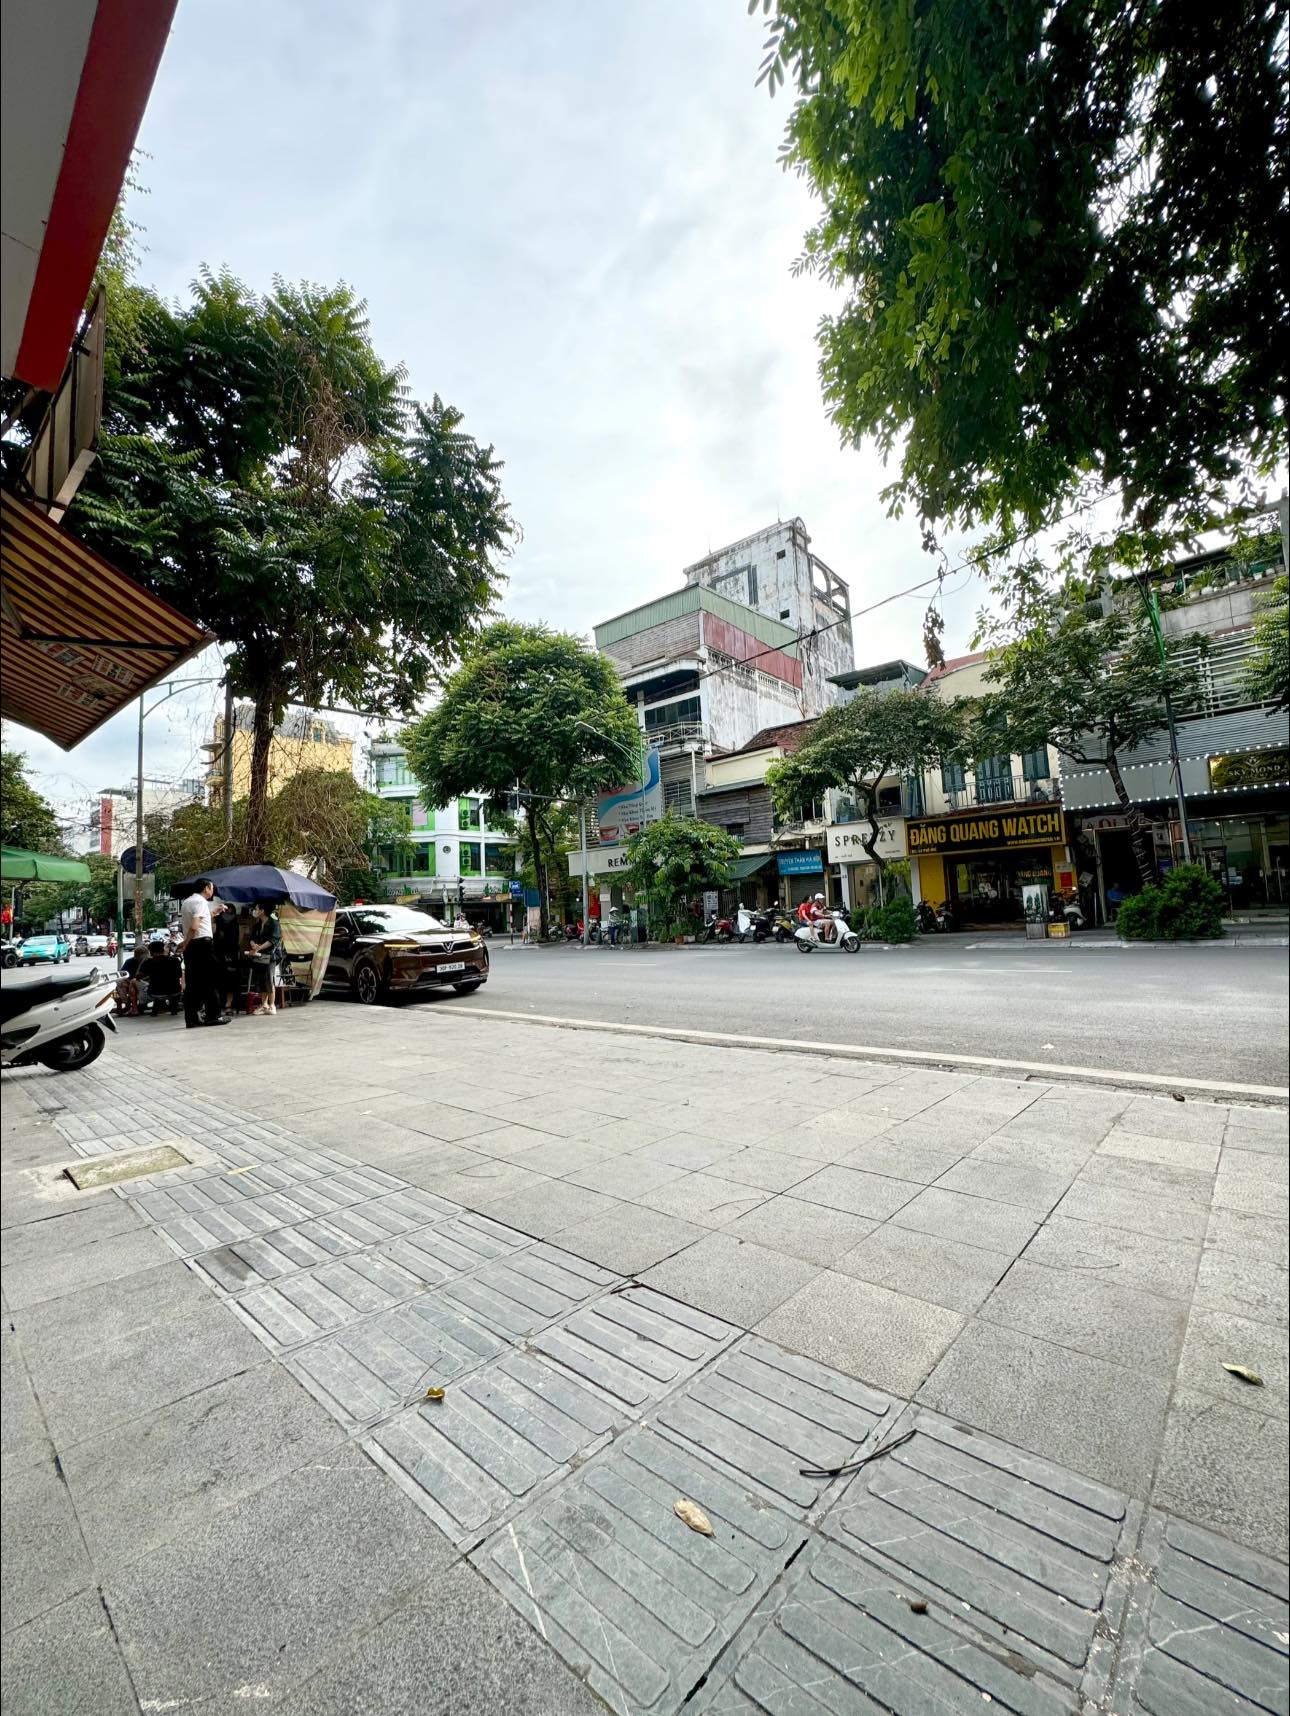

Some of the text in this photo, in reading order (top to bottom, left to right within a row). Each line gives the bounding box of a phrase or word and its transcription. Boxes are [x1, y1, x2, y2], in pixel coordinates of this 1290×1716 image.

[834, 830, 896, 847] SPREZY
[910, 824, 947, 846] ĐĂNG
[950, 820, 999, 842] QUANG
[1002, 813, 1060, 837] WATCH
